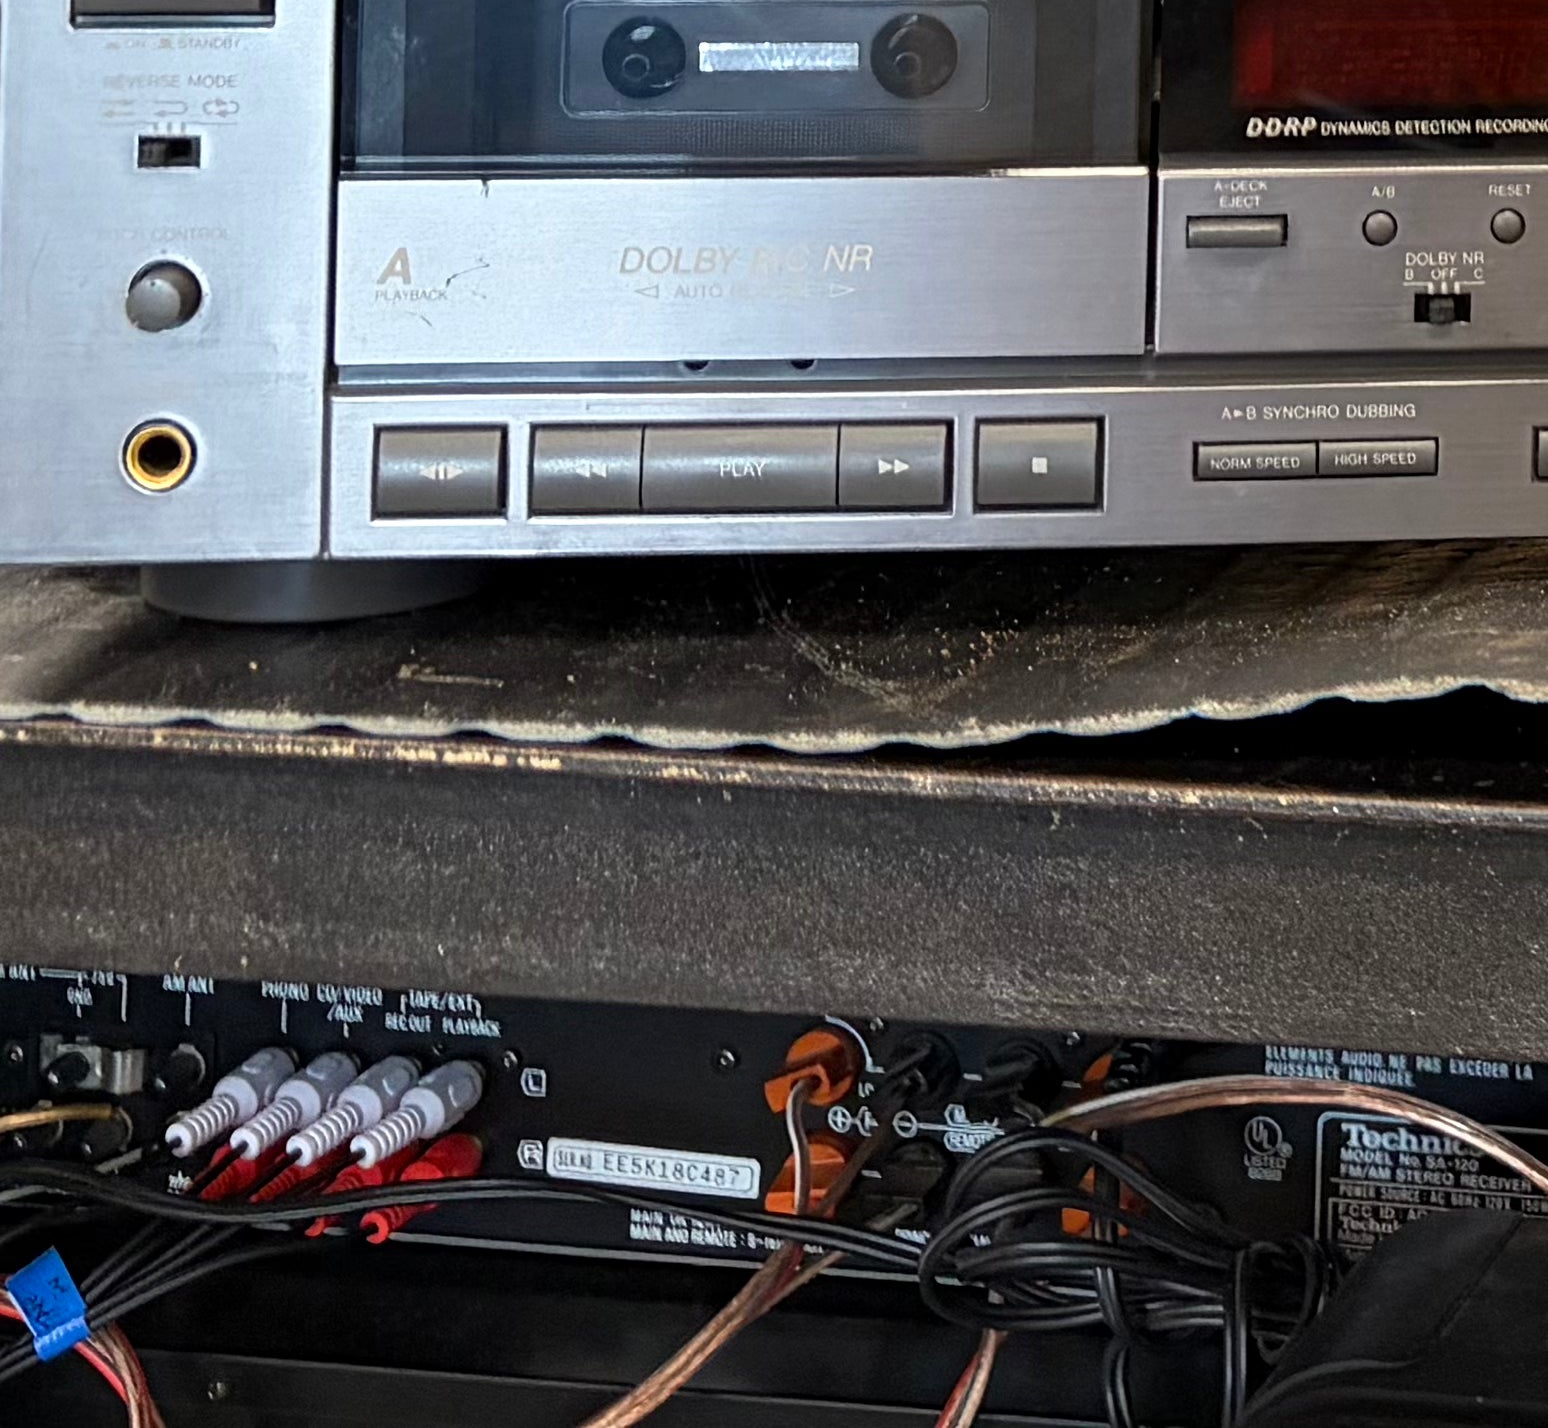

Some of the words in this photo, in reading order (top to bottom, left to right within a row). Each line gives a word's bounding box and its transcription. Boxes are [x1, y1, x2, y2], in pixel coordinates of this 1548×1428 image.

[177, 38, 241, 50] STANDBY
[187, 74, 240, 89] MODE
[1245, 116, 1318, 138] DDRP
[1320, 120, 1391, 137] DYNAMICS
[1395, 118, 1472, 135] DETECTION
[1371, 185, 1396, 199] A/B
[1488, 183, 1531, 197] RESET
[1219, 195, 1261, 209] EJECT
[376, 247, 412, 285] A
[619, 245, 738, 275] DOLBY
[823, 244, 874, 272] NR
[1405, 252, 1458, 266] DOLBY
[1462, 251, 1485, 265] NR
[1404, 268, 1414, 280] B
[1430, 267, 1458, 280] OFF
[1473, 267, 1484, 280] C
[375, 288, 448, 302] PLAYBACK
[674, 284, 723, 299] AUTO
[1262, 404, 1340, 420] SYNCHRO
[1345, 403, 1417, 419] DUBBING
[1210, 456, 1253, 471] NORM
[1255, 454, 1300, 470] SPEED
[1334, 452, 1368, 467] HIGH
[1372, 450, 1417, 466] SPEED
[719, 460, 768, 479] PLAY
[261, 980, 310, 1001] PHONO
[1415, 1054, 1443, 1074] PAS
[1514, 1061, 1535, 1081] LA
[1340, 1147, 1393, 1166] MODEL
[1339, 1163, 1392, 1181] FM/AM
[1395, 1167, 1455, 1186] STEREO
[1459, 1173, 1533, 1193] RECEIVER
[1337, 1201, 1373, 1218] FCC
[629, 1224, 664, 1241] MAIN
